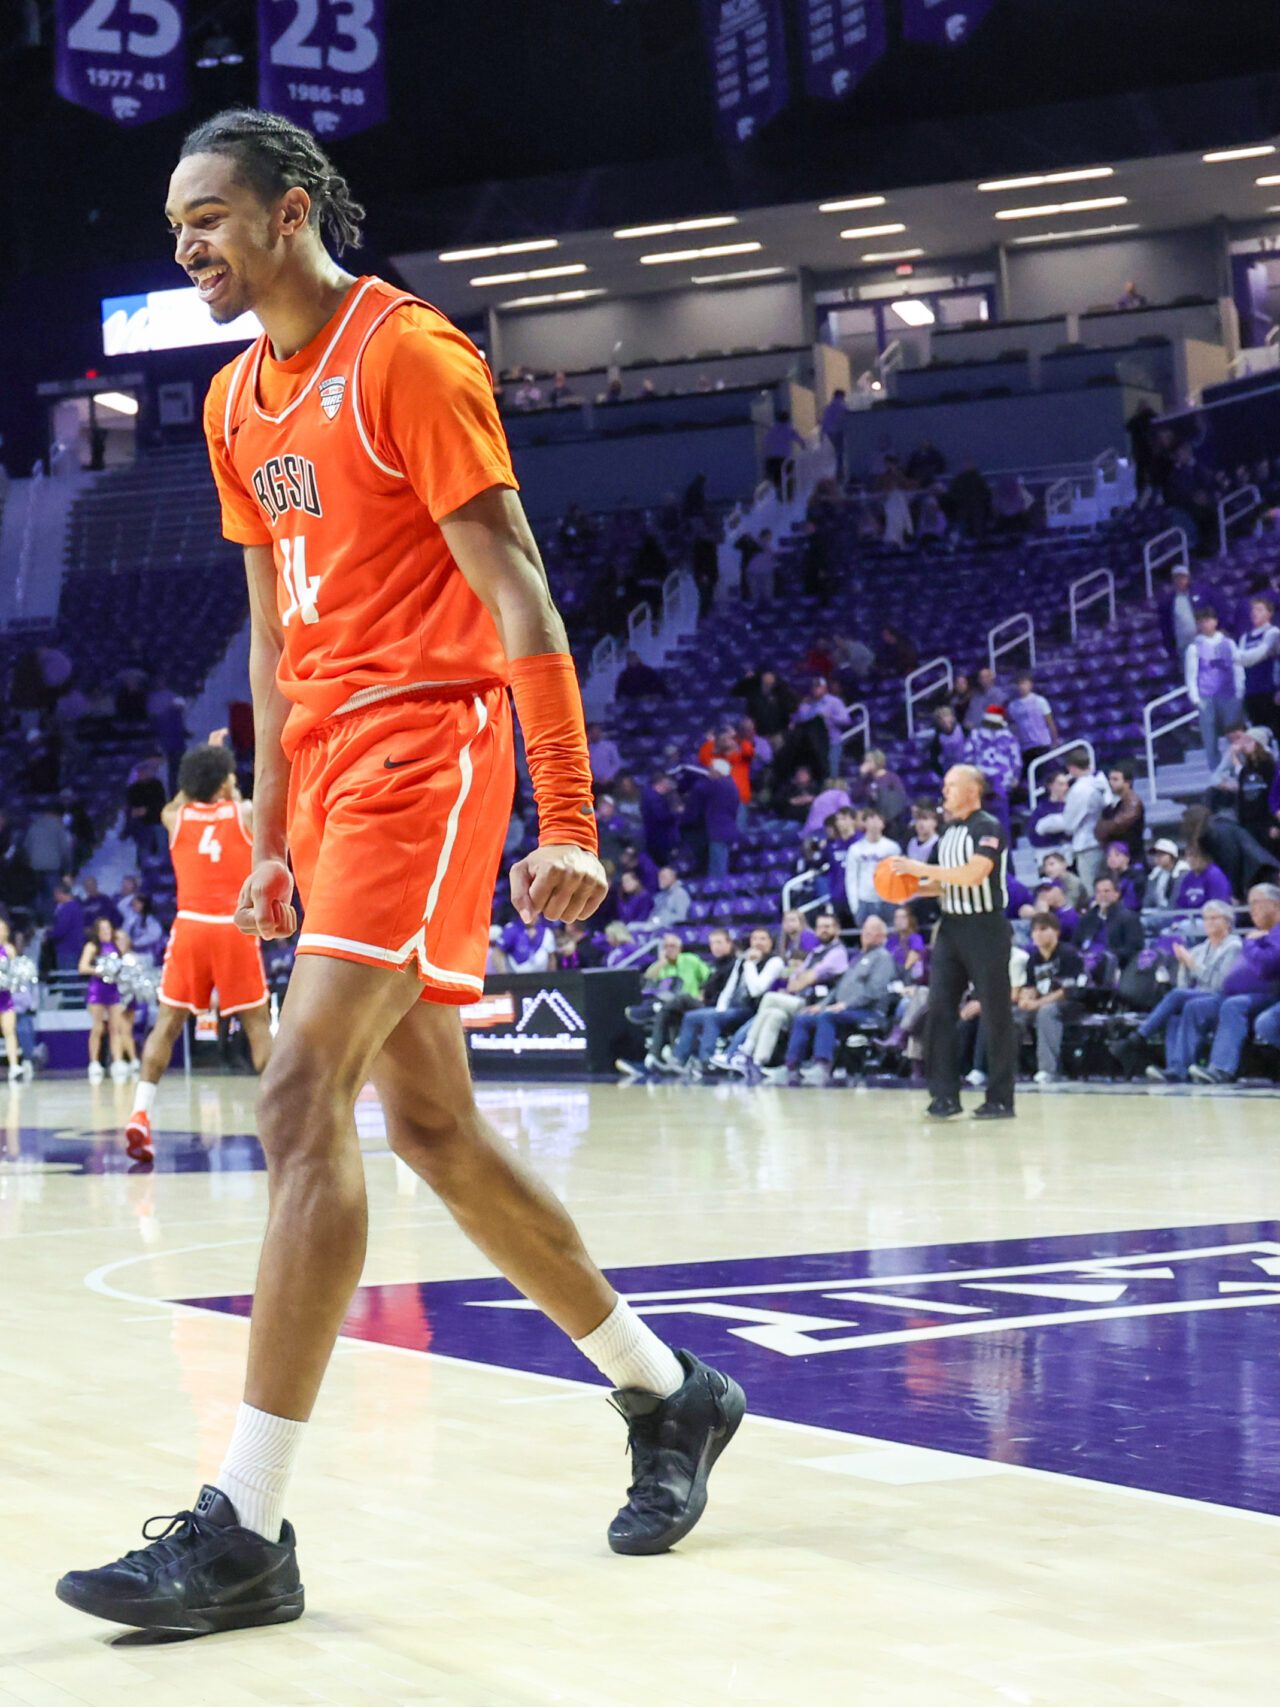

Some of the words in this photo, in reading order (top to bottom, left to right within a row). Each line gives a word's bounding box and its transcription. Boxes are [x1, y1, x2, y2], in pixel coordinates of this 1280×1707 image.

[67, 0, 182, 58] 25
[270, 0, 379, 73] 23
[251, 453, 324, 527] BGSU
[197, 824, 222, 863] 4
